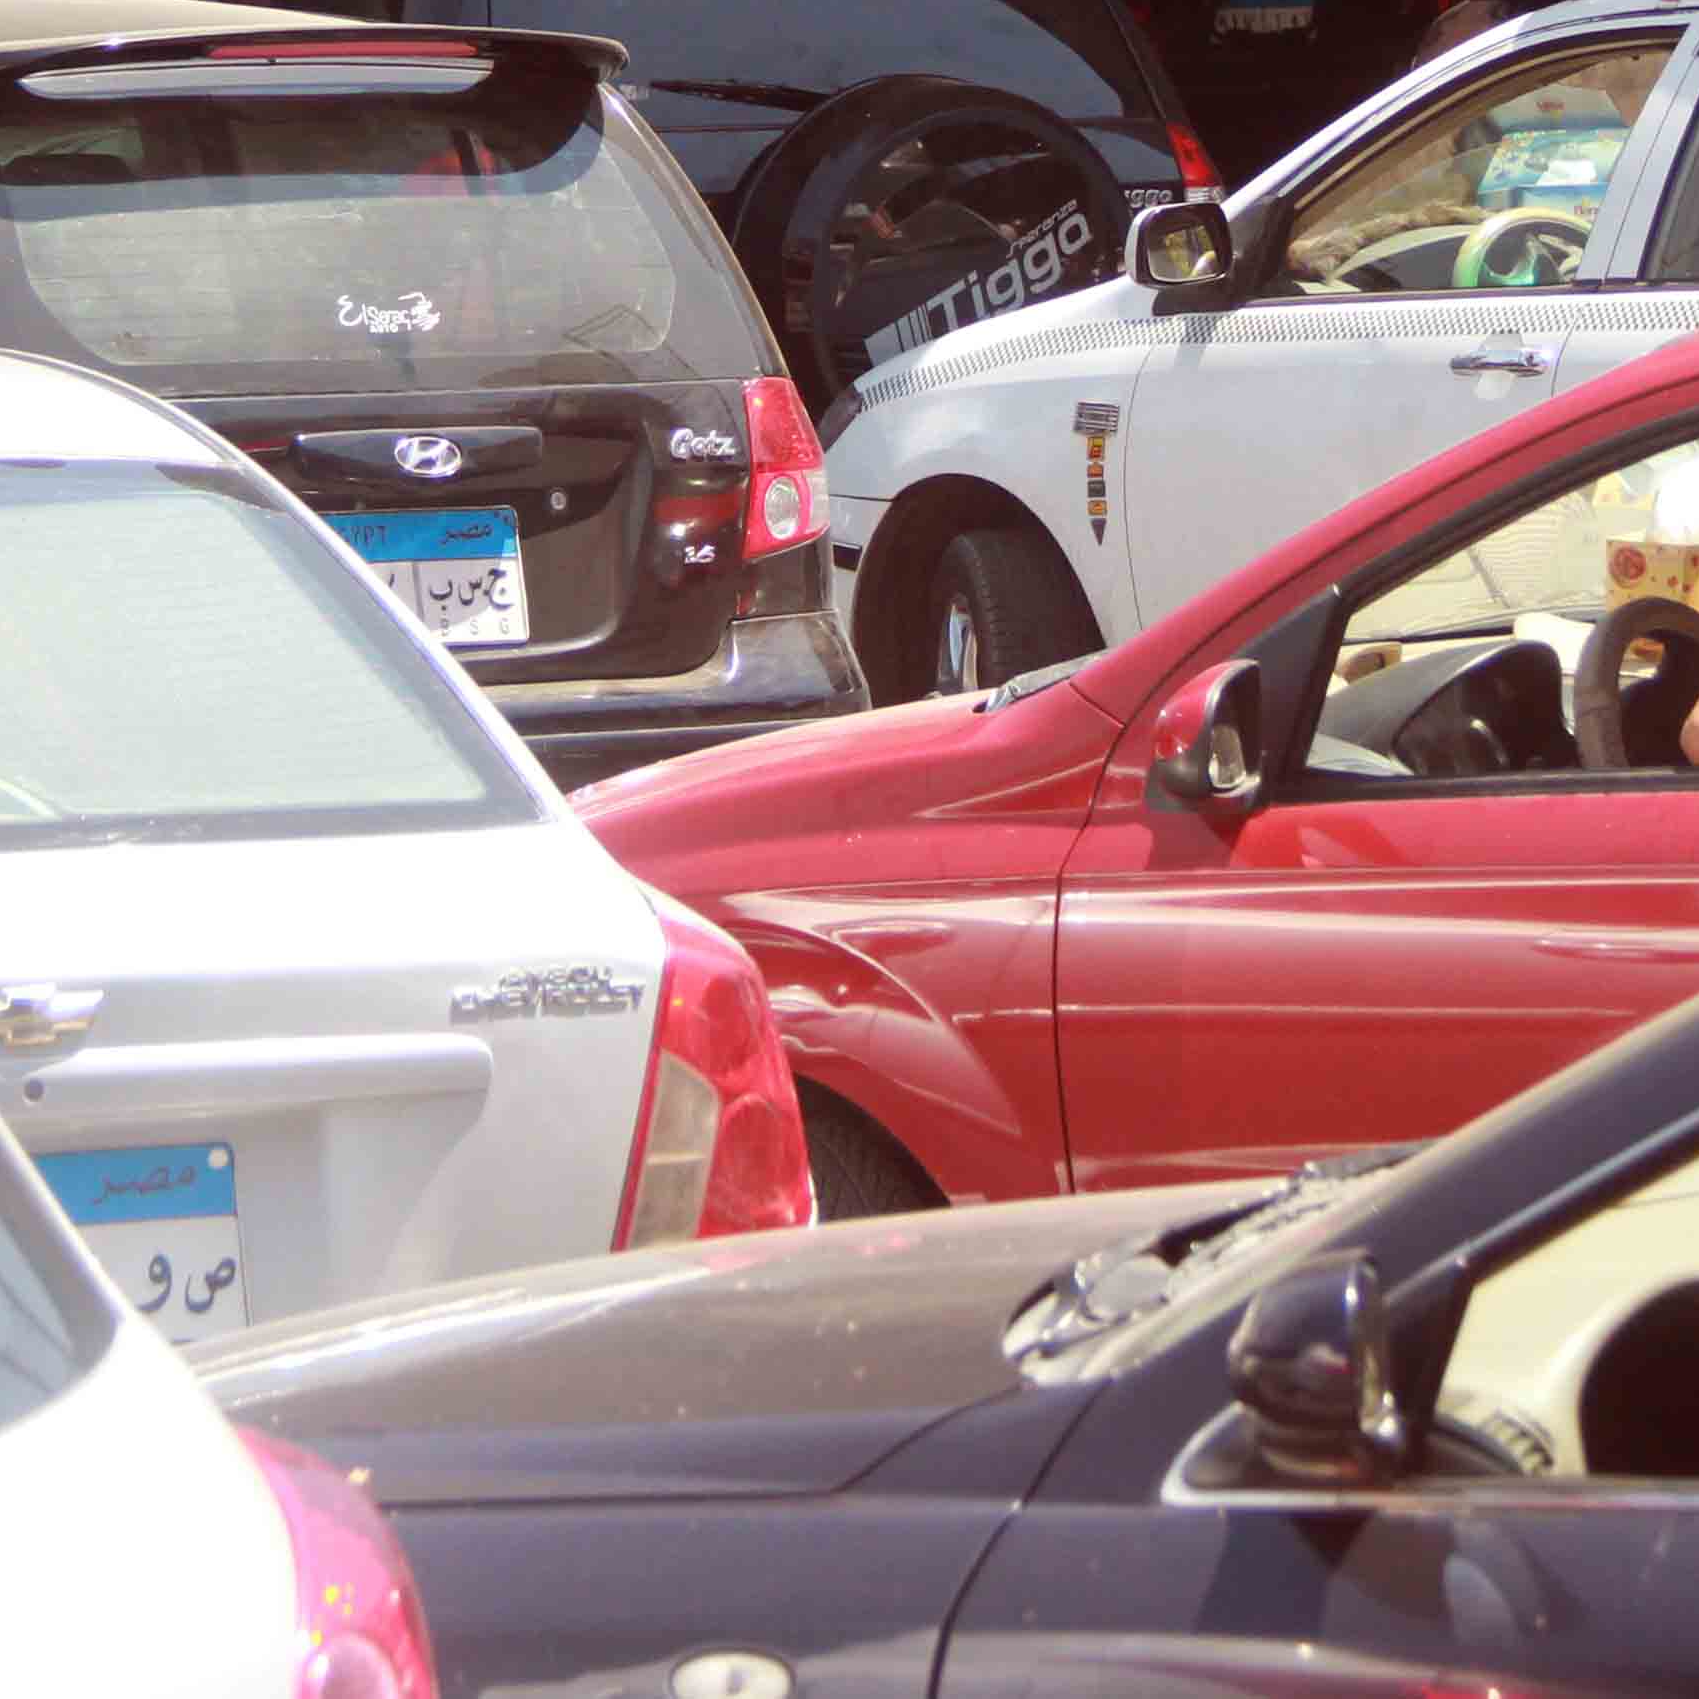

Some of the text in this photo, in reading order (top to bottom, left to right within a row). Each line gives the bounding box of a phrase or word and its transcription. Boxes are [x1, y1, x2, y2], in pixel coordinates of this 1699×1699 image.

[925, 212, 1093, 332] Tiggo
[440, 523, 492, 545] مصر
[89, 1165, 197, 1206] مصر
